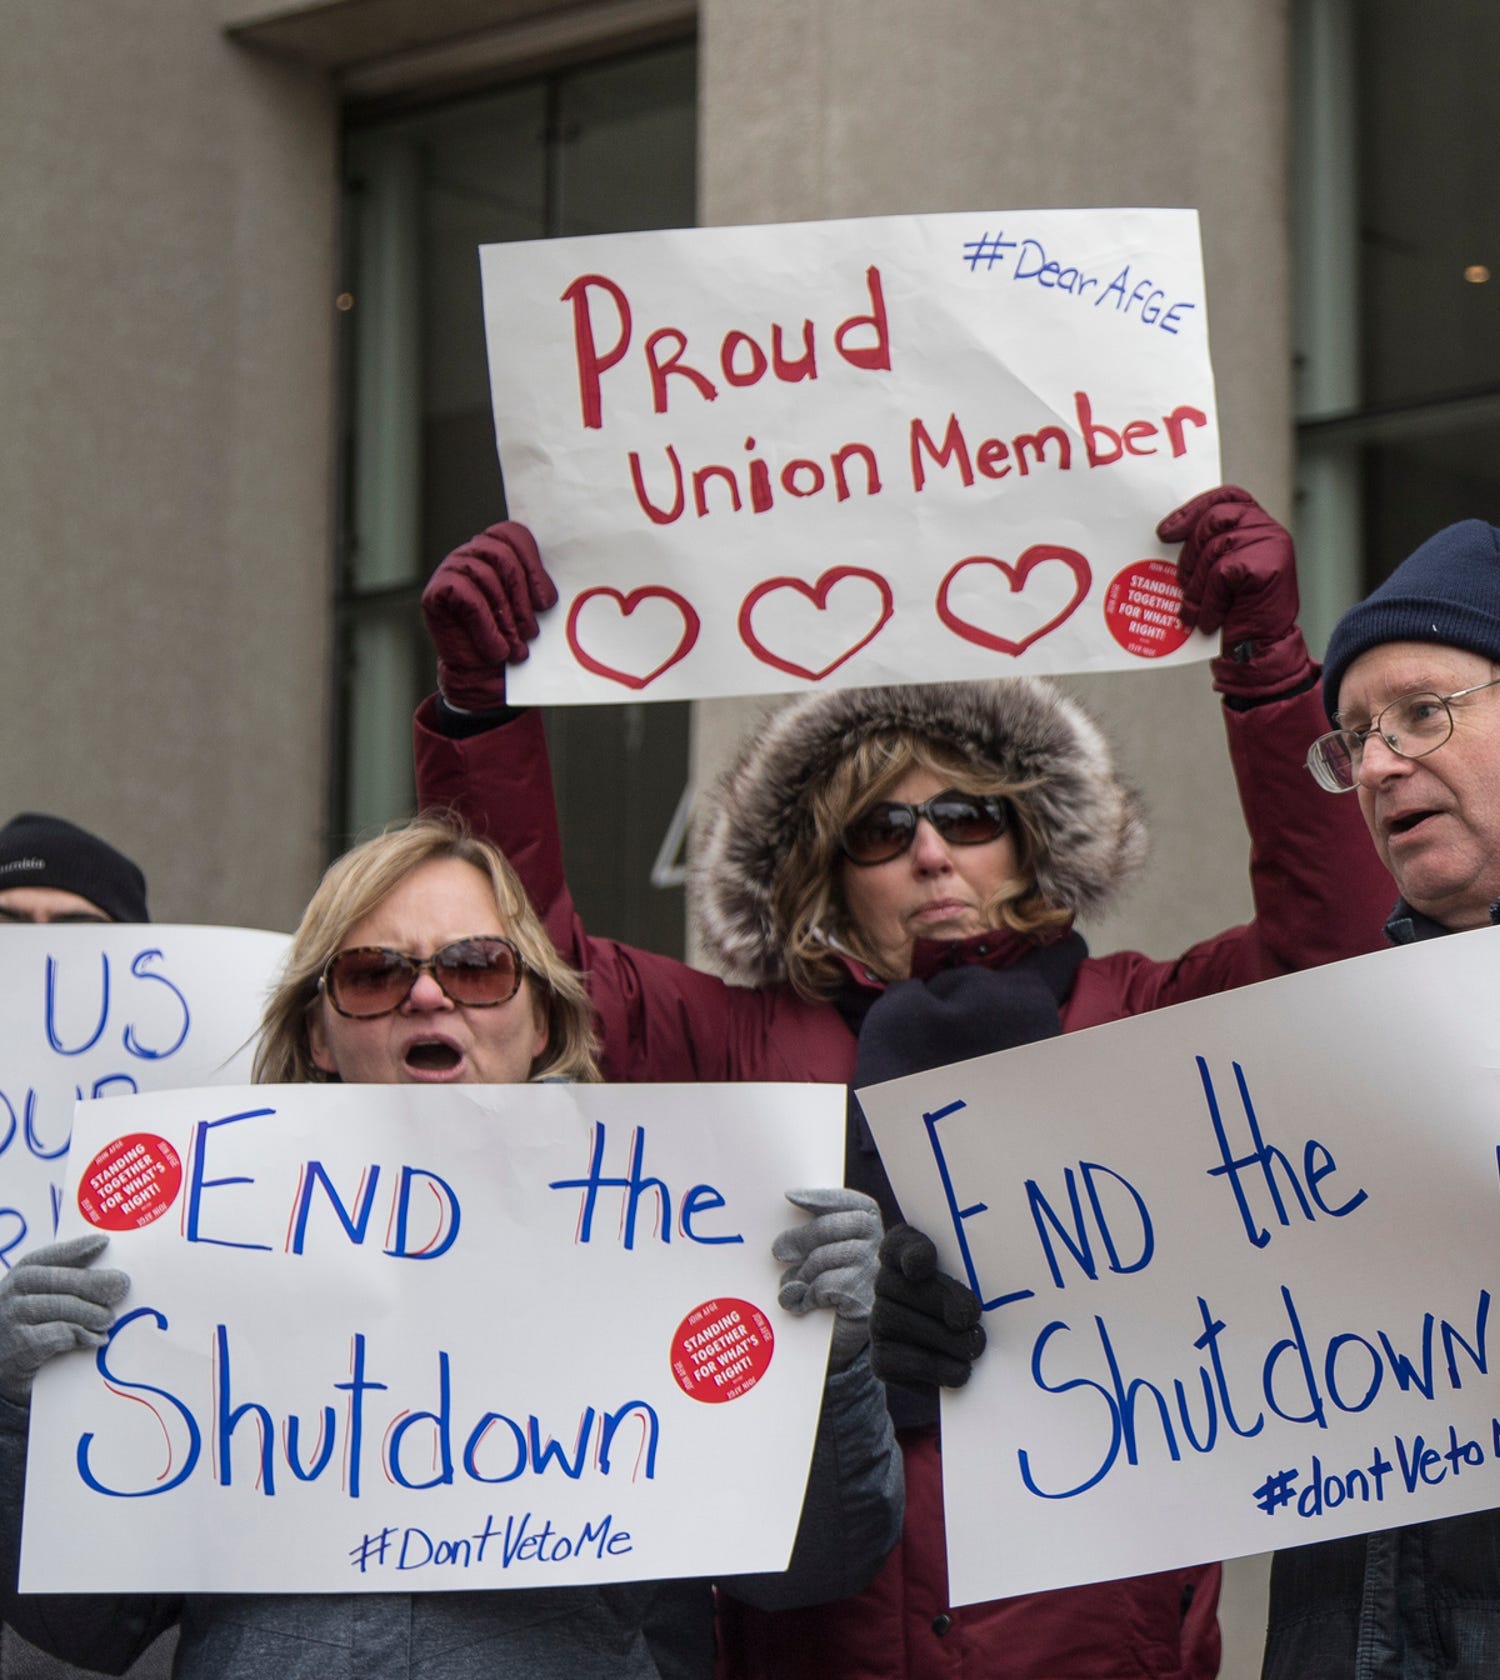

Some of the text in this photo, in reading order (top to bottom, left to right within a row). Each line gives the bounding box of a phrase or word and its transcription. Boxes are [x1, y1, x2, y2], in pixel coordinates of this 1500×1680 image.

[629, 391, 1207, 525] Union Member
[1119, 602, 1182, 630] FOR WHAT'S
[1128, 620, 1167, 641] RIGHT!
[45, 948, 190, 1060] US
[90, 1143, 146, 1189] STANDING
[97, 1154, 153, 1199] TOGETHER
[100, 1161, 166, 1213] FOR WHAT'S
[183, 1107, 462, 1261] END
[548, 1120, 744, 1250] the
[922, 1055, 1368, 1312] END the
[120, 1182, 162, 1215] RIGHT!
[683, 1310, 741, 1353] STANDING
[690, 1324, 748, 1365] TOGETHER
[693, 1334, 760, 1382] FOR WHAT'S
[714, 1356, 753, 1387] RIGHT!
[76, 1306, 660, 1499] Shutdown
[349, 1512, 634, 1574] #DontVetoMe
